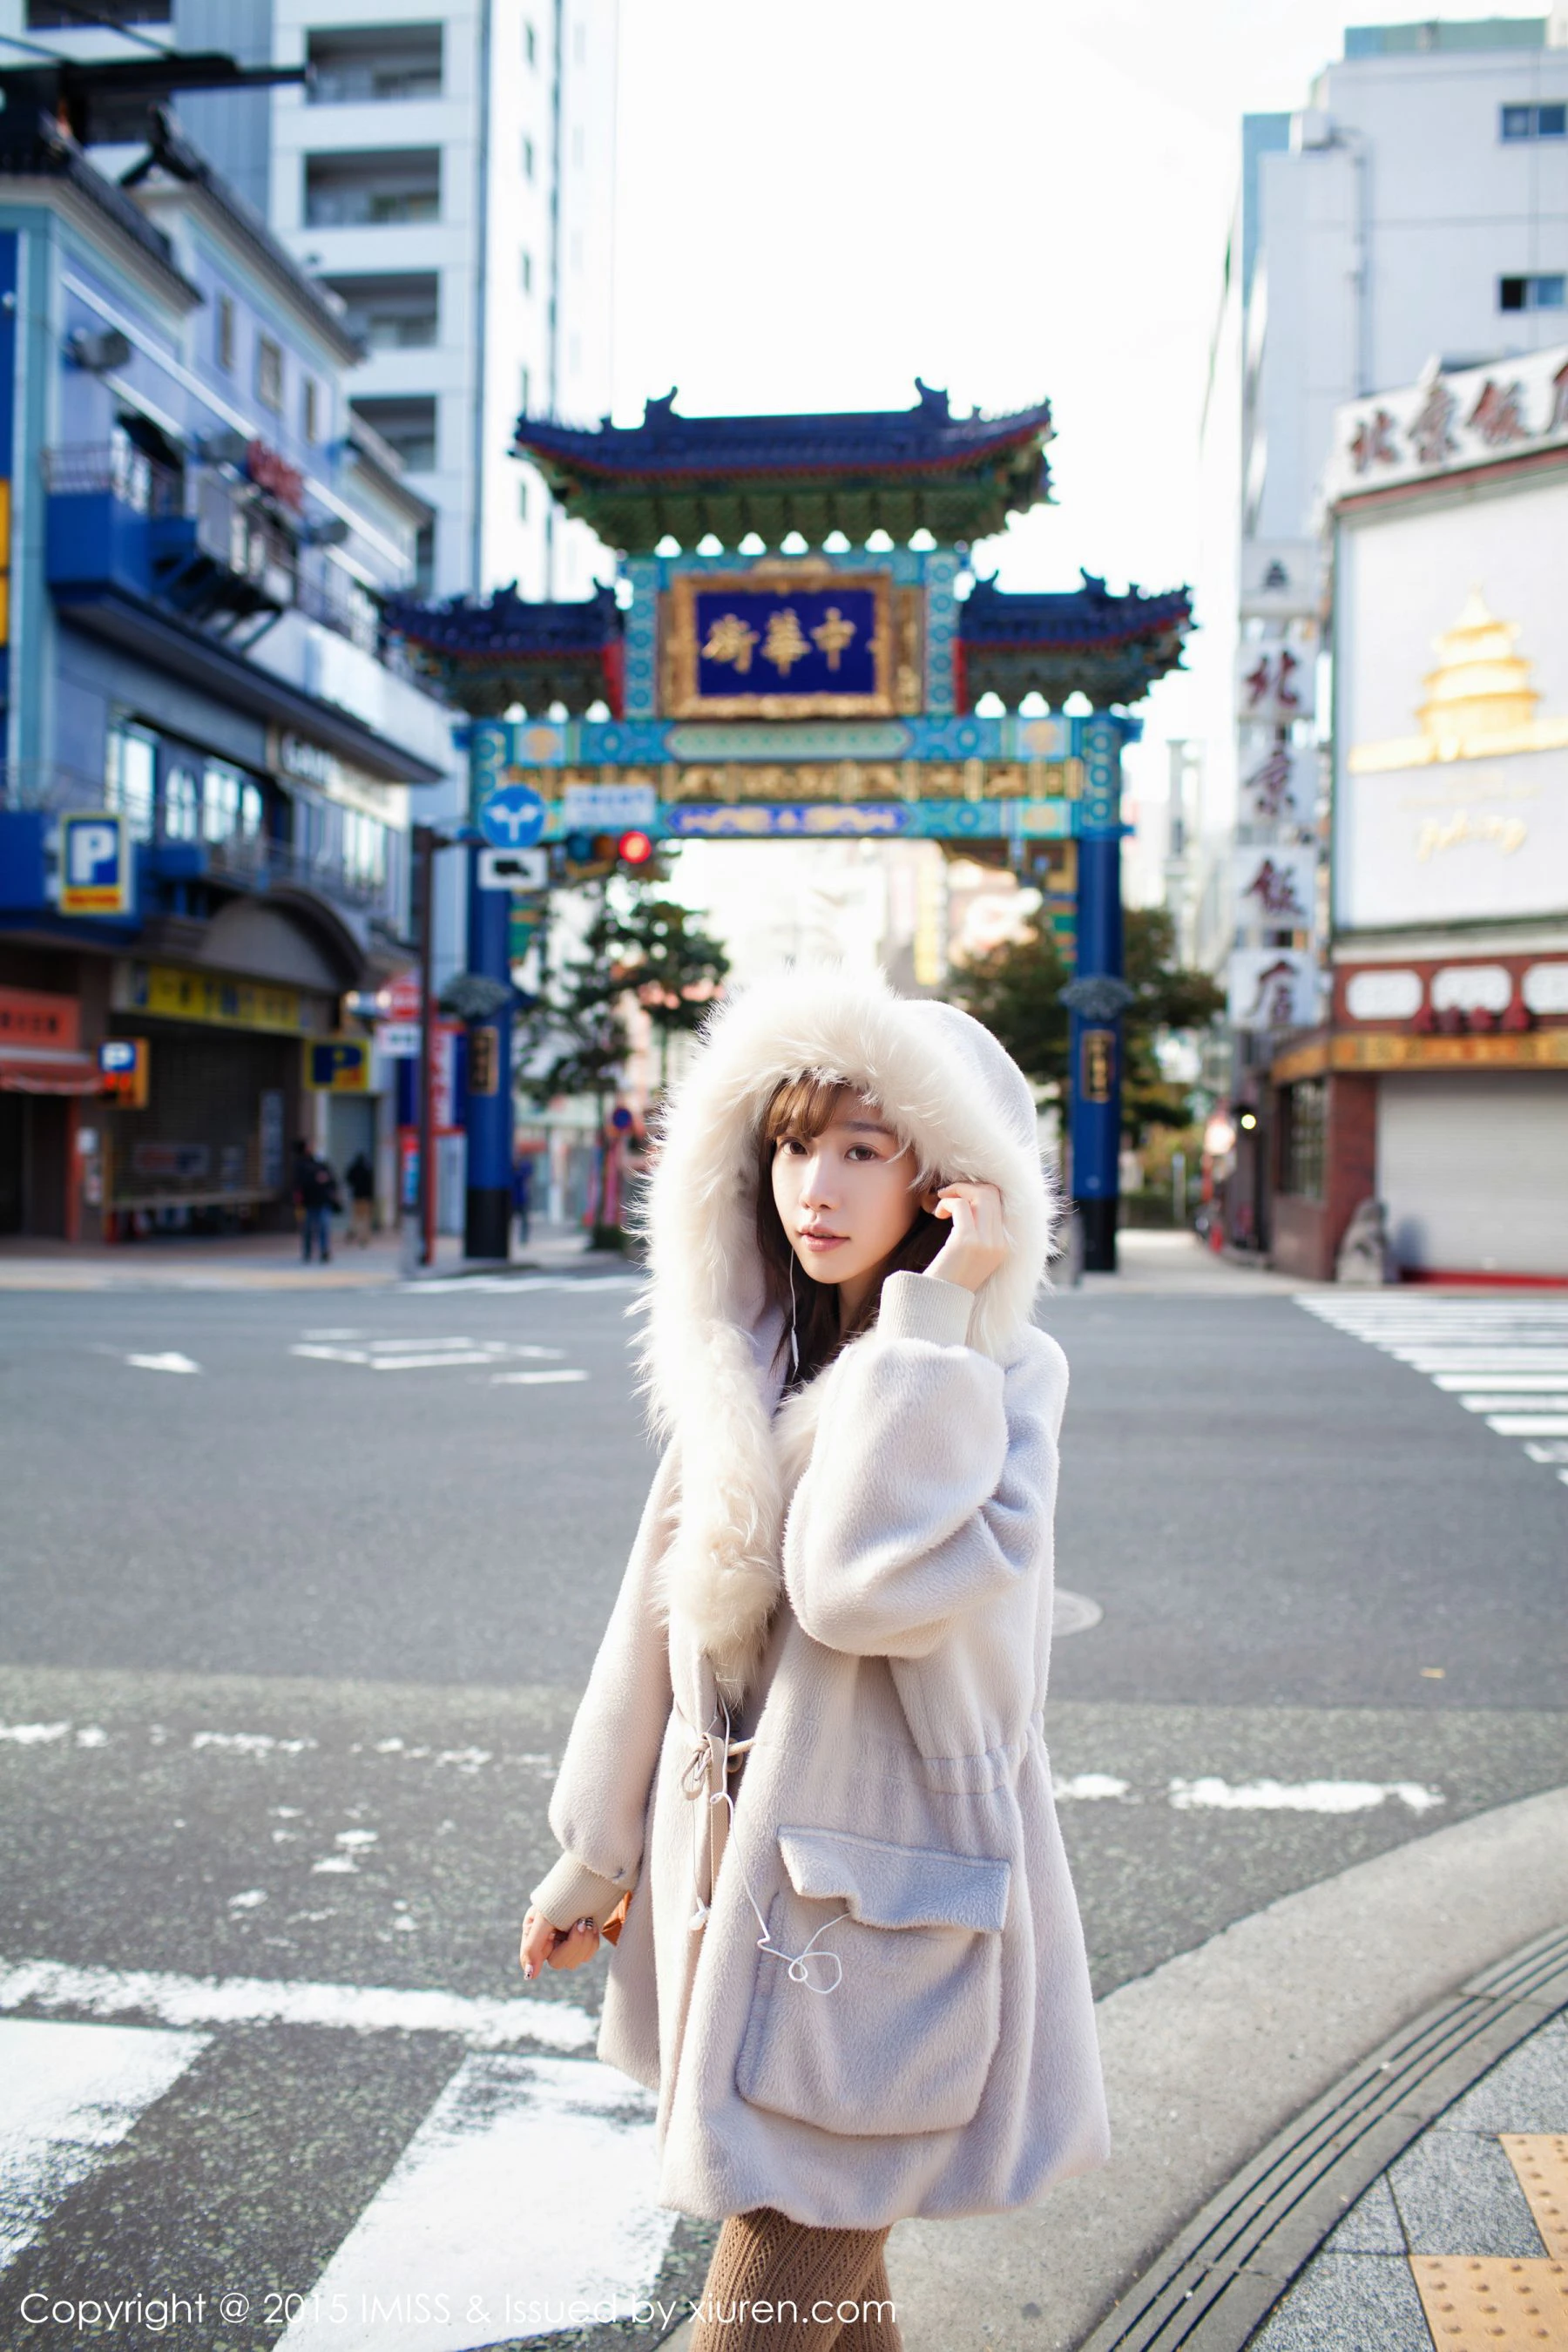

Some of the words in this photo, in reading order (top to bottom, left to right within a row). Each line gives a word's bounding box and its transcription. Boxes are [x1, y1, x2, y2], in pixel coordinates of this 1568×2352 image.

[71, 824, 116, 882] P
[1243, 650, 1305, 1026] 北京飯店
[313, 1044, 362, 1084] P
